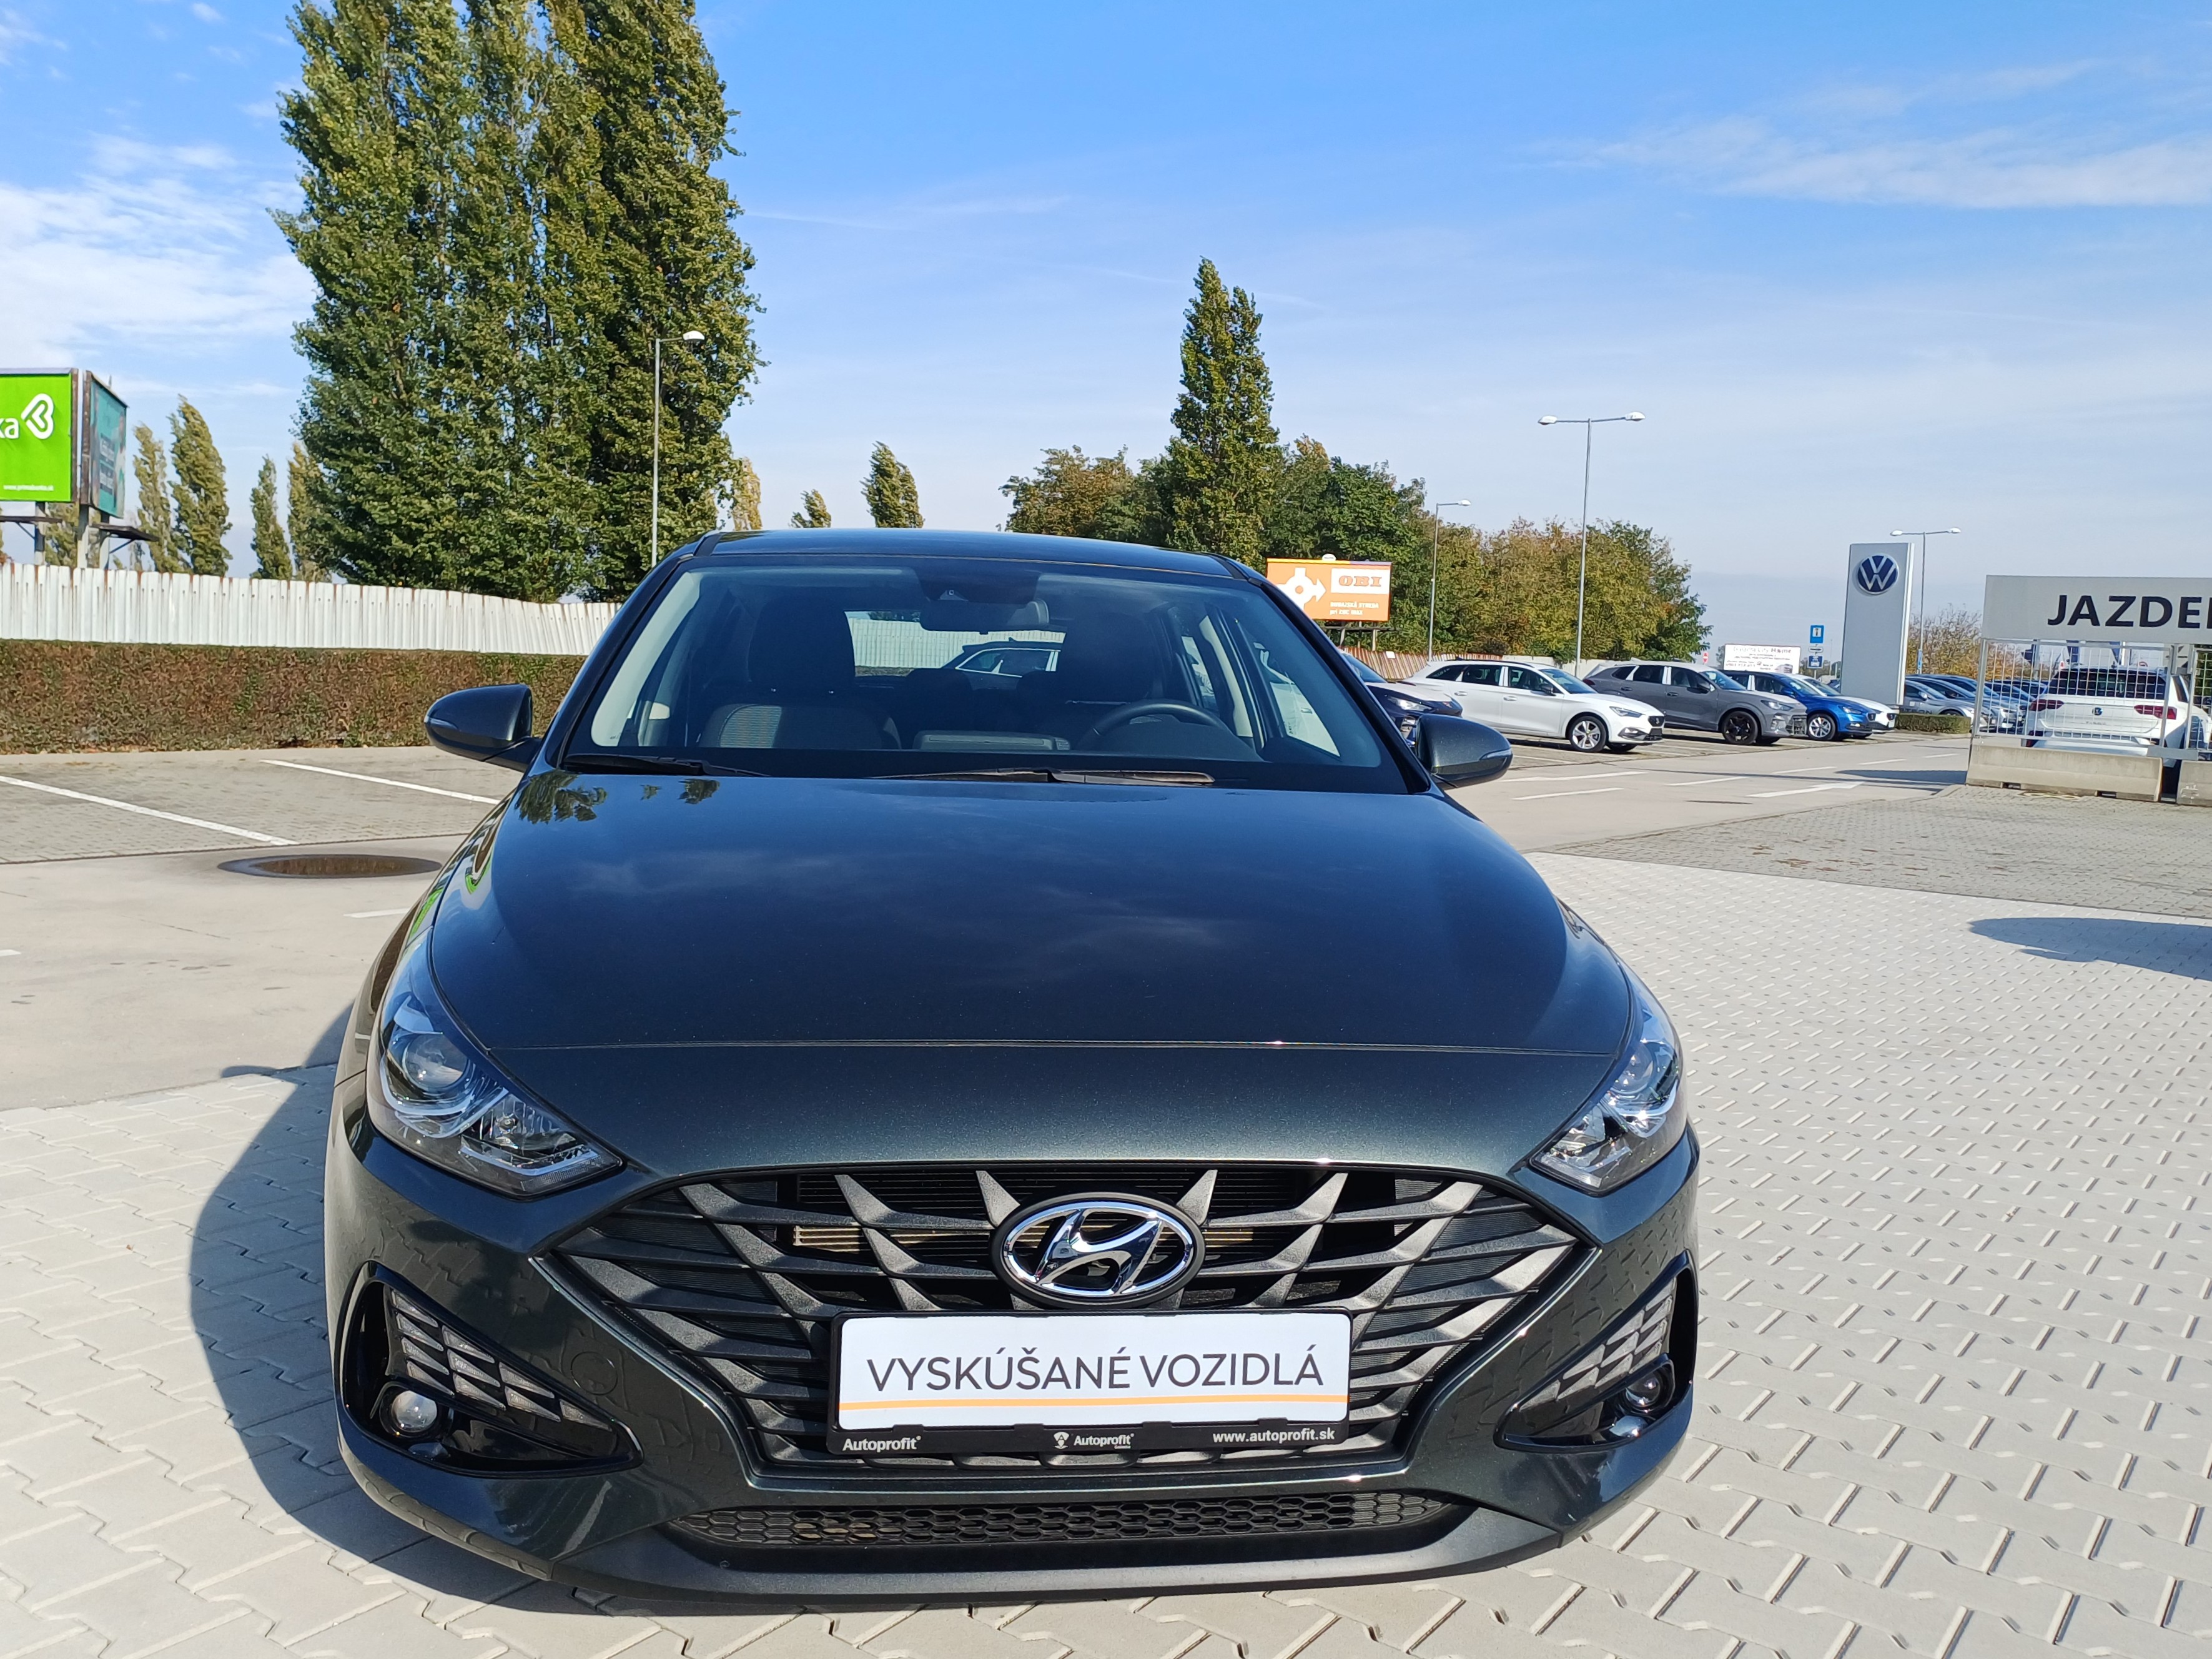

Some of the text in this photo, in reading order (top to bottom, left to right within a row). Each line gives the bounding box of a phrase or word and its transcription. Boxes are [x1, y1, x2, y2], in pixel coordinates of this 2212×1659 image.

[1338, 575, 1382, 587] OBI
[866, 1344, 1324, 1392] VYSKÚŠANÉ VOZIDLÁ
[1074, 1434, 1132, 1447] Autoprofit
[1212, 1427, 1335, 1444] www.autoprofit.sk
[842, 1436, 918, 1453] Autoprofit
